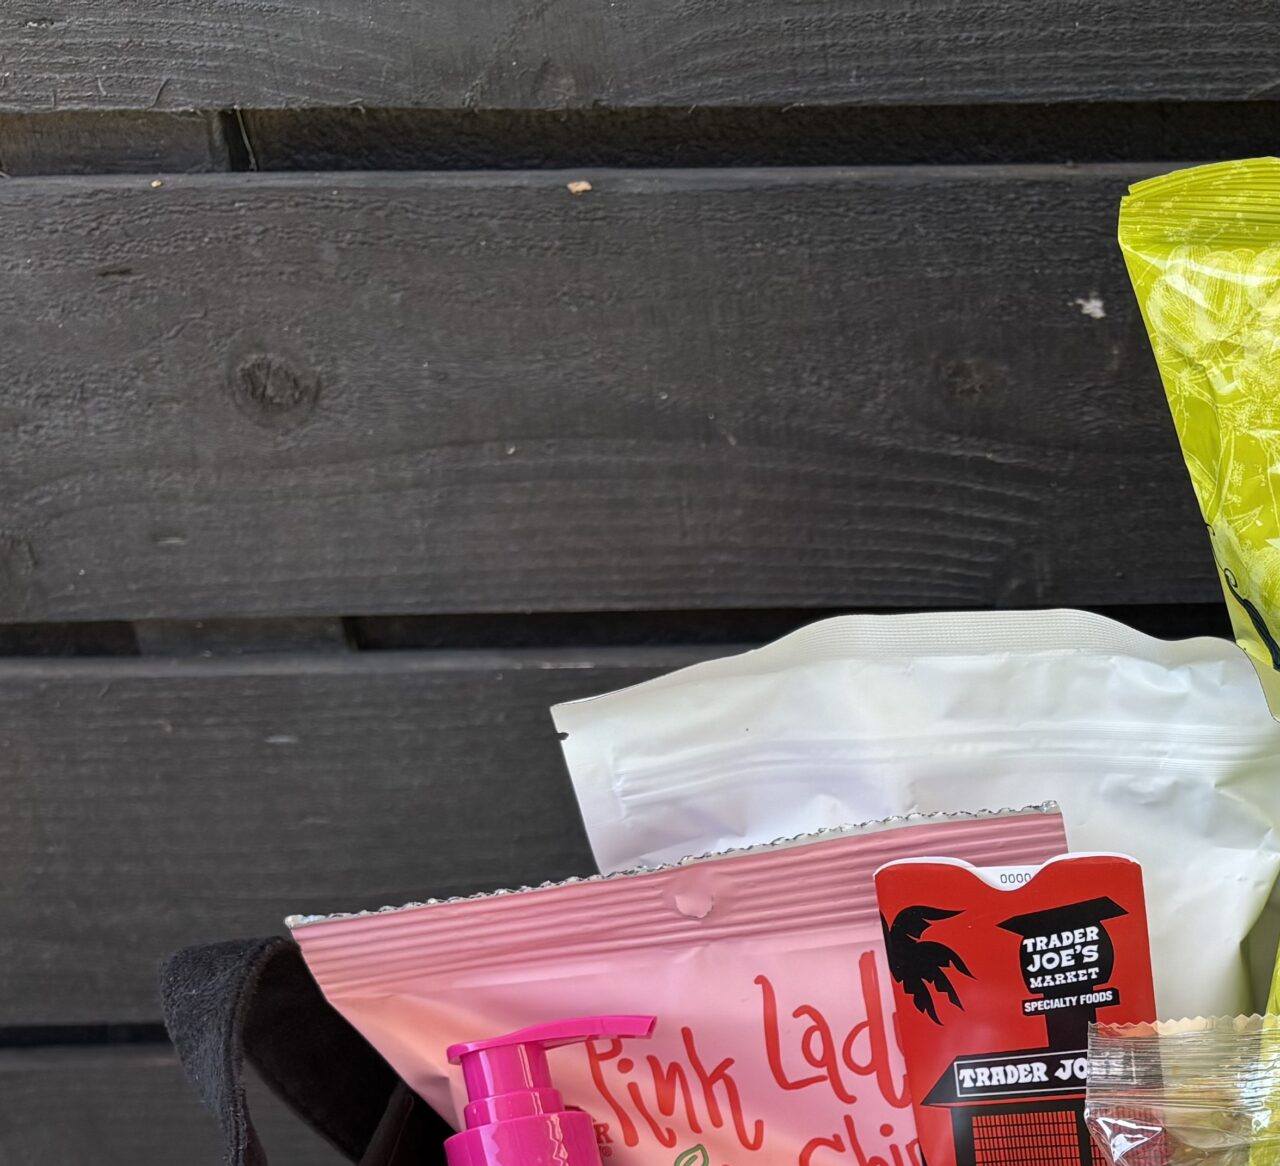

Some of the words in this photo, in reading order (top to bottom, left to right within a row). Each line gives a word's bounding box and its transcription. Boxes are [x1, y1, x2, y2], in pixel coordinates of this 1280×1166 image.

[1022, 925, 1100, 953] TRADER
[1026, 944, 1100, 973] JOE'S
[1029, 967, 1100, 989] MARKET
[1023, 995, 1077, 1014] SPECIALTY
[1079, 990, 1113, 1006] FOODS
[585, 1027, 764, 1150] Pink
[754, 950, 912, 1109] Lad
[958, 1058, 1049, 1089] TRADER
